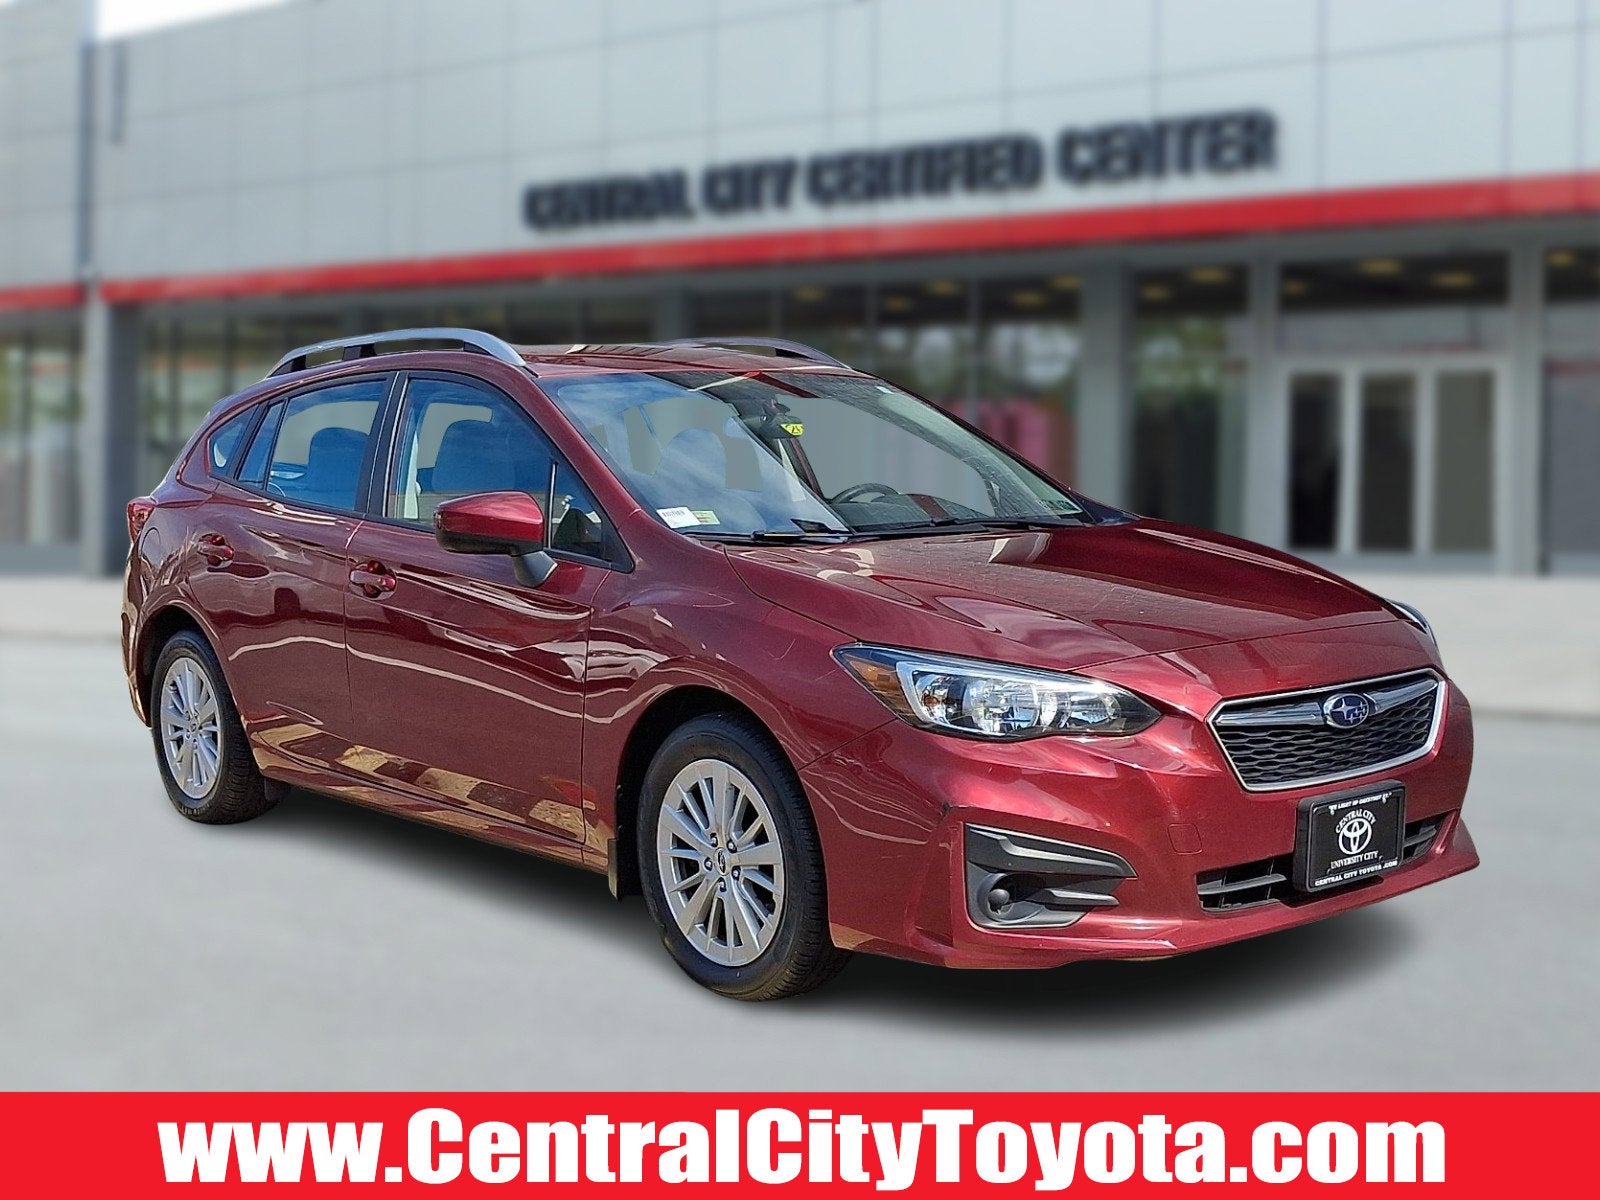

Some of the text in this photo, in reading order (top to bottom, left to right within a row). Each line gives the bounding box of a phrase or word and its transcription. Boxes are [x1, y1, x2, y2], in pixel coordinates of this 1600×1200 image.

[524, 108, 1276, 232] CENTRAL CITY CERTIFIED CENTER
[1335, 809, 1377, 834] CENTRAL CITY
[1330, 850, 1379, 869] UNIVERSITY CITY
[1314, 875, 1344, 887] CENTRAL
[1343, 870, 1358, 880] CITY
[1359, 864, 1382, 875] TOYOTA
